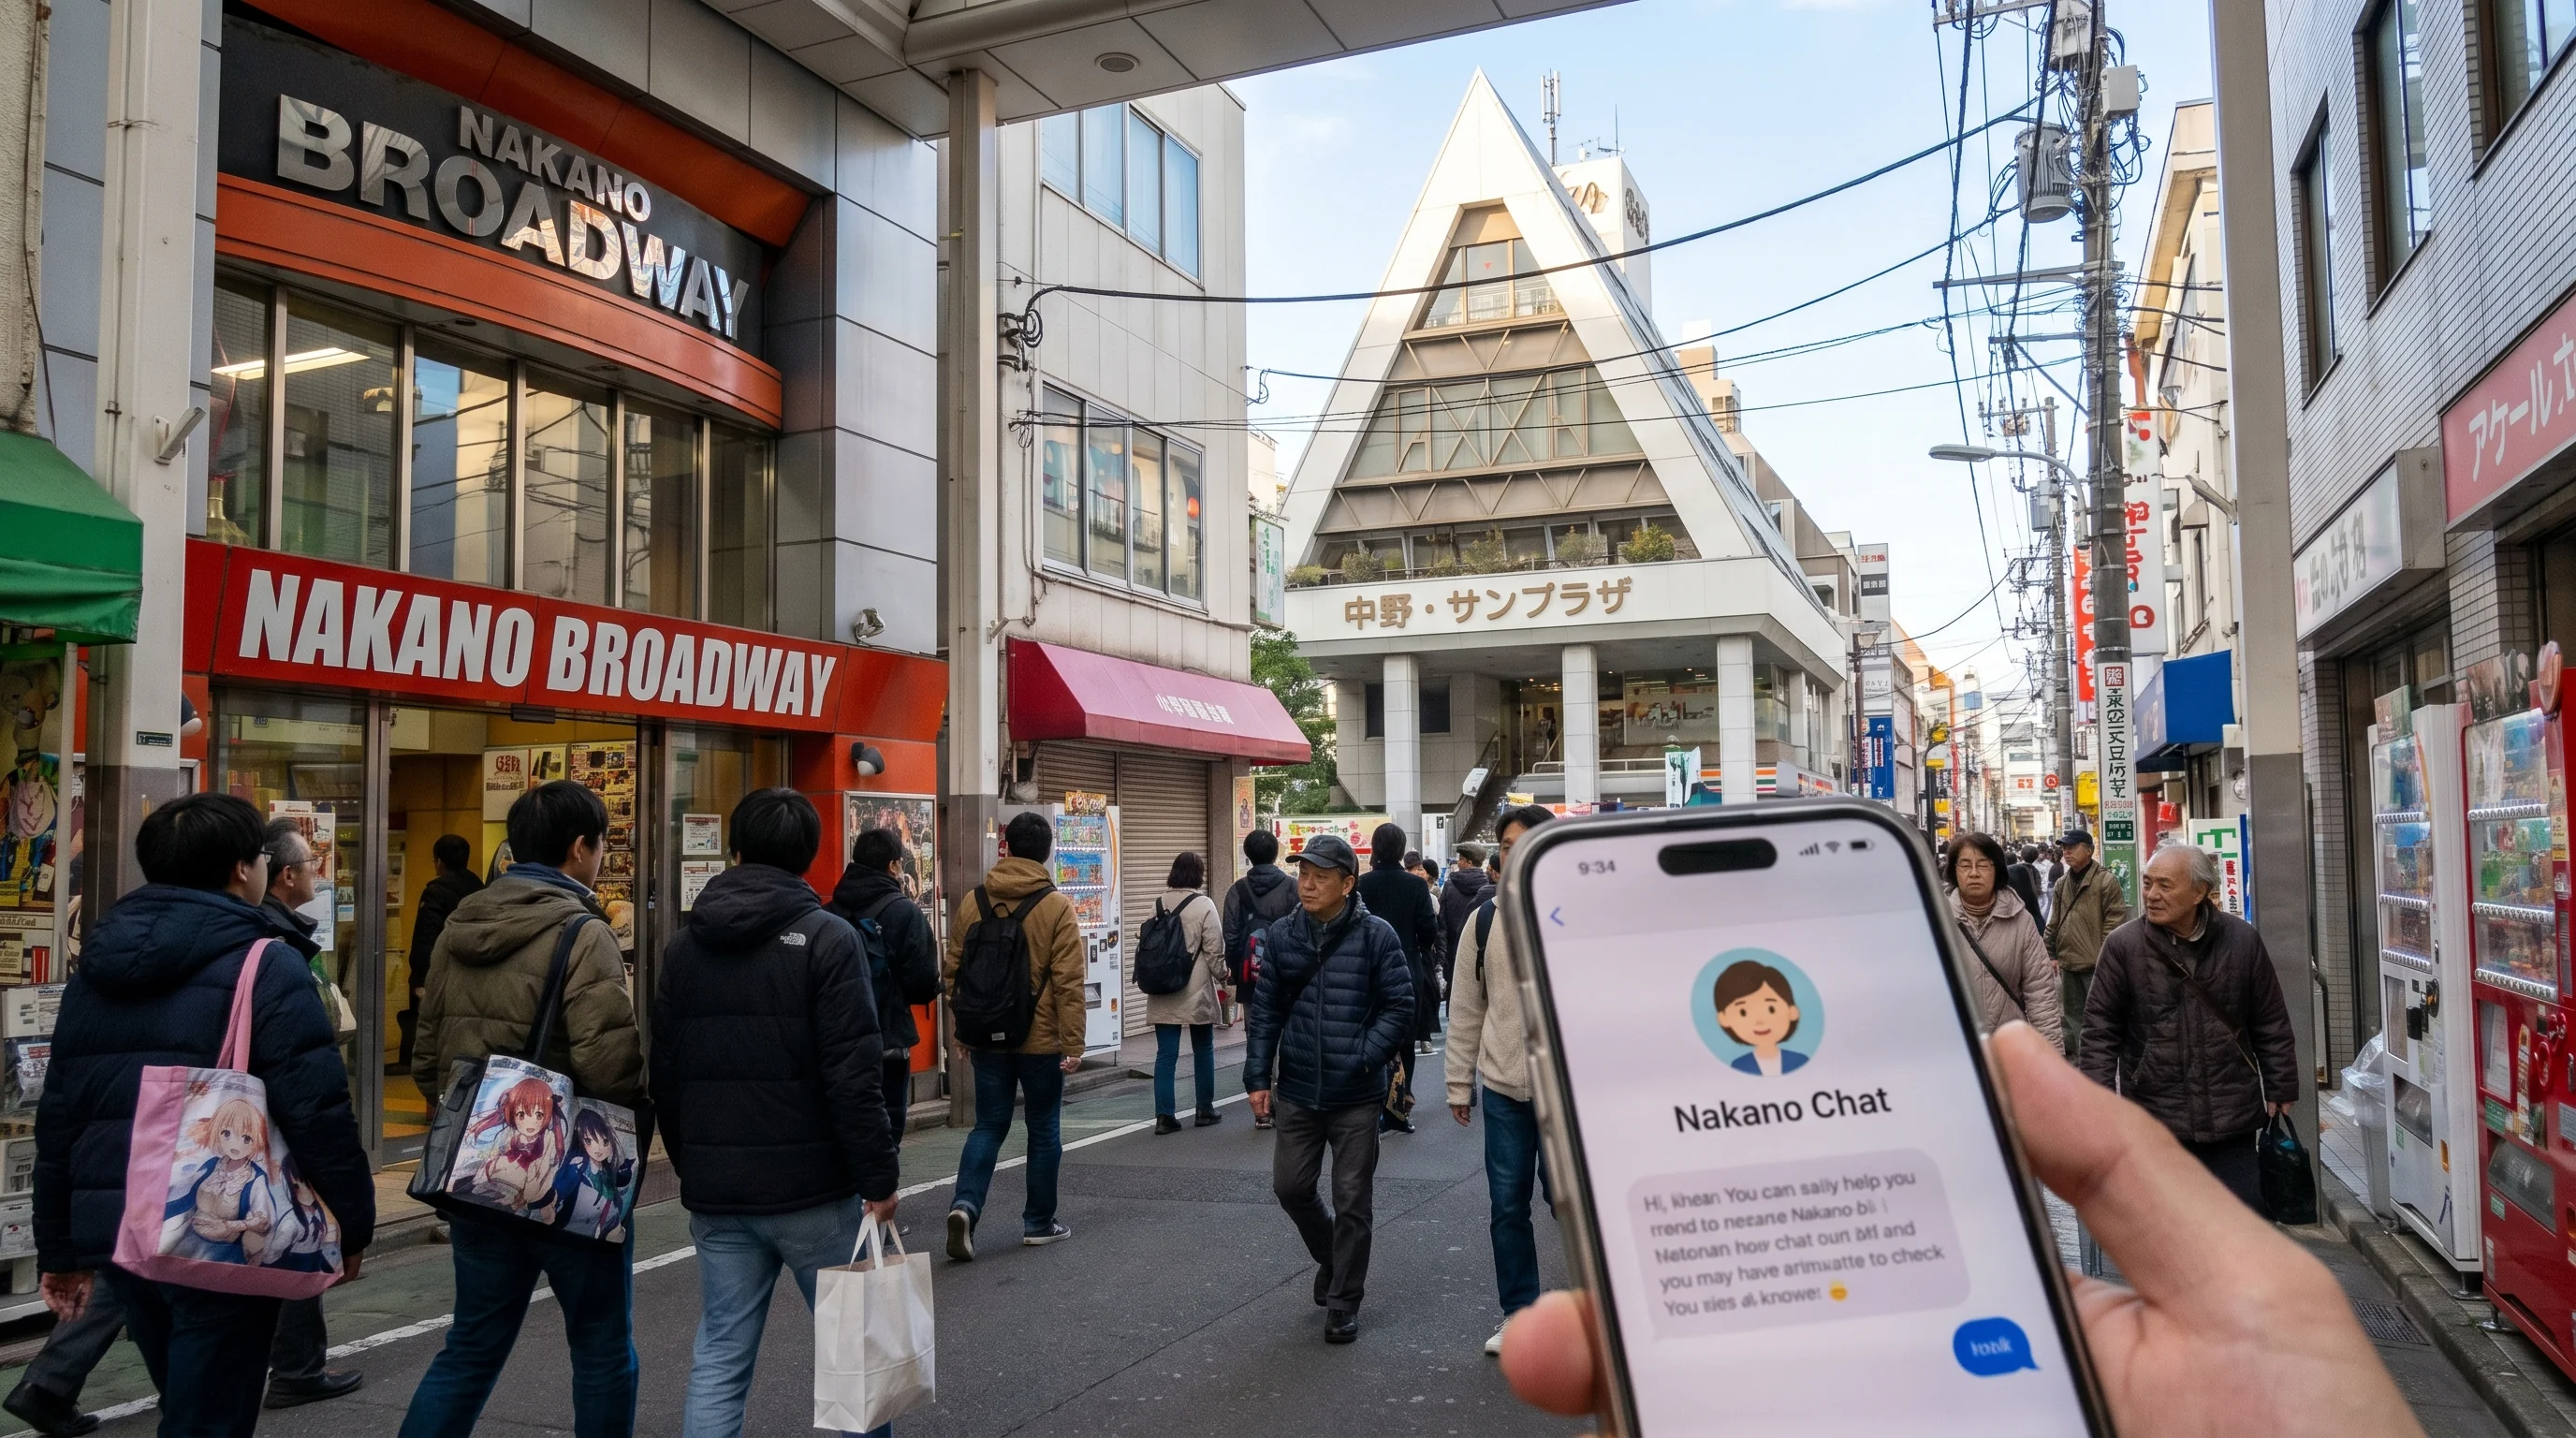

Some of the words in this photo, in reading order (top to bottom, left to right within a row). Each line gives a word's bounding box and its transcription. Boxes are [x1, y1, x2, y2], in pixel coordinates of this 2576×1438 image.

[459, 105, 651, 223] NAKANO
[277, 94, 749, 340] BROADWAY
[1345, 576, 1632, 630] 中野・サンプラザ
[239, 568, 535, 687] NAKANO
[547, 615, 837, 717] BROADWAY
[1578, 859, 1617, 875] 9:34
[1674, 1099, 1804, 1133] Nakano
[1810, 1087, 1892, 1119] Chat
[1724, 1186, 1758, 1203] You
[1762, 1183, 1796, 1199] can
[1842, 1173, 1881, 1192] help
[1884, 1172, 1916, 1190] you
[1701, 1217, 1720, 1234] to
[1792, 1204, 1853, 1224] Nakano
[1775, 1233, 1813, 1251] chat
[1883, 1220, 1916, 1239] and
[1660, 1274, 1692, 1294] you
[1696, 1270, 1733, 1287] may
[1737, 1264, 1779, 1282] have
[1869, 1252, 1889, 1267] to
[1892, 1243, 1945, 1263] check
[1663, 1299, 1699, 1317] You
